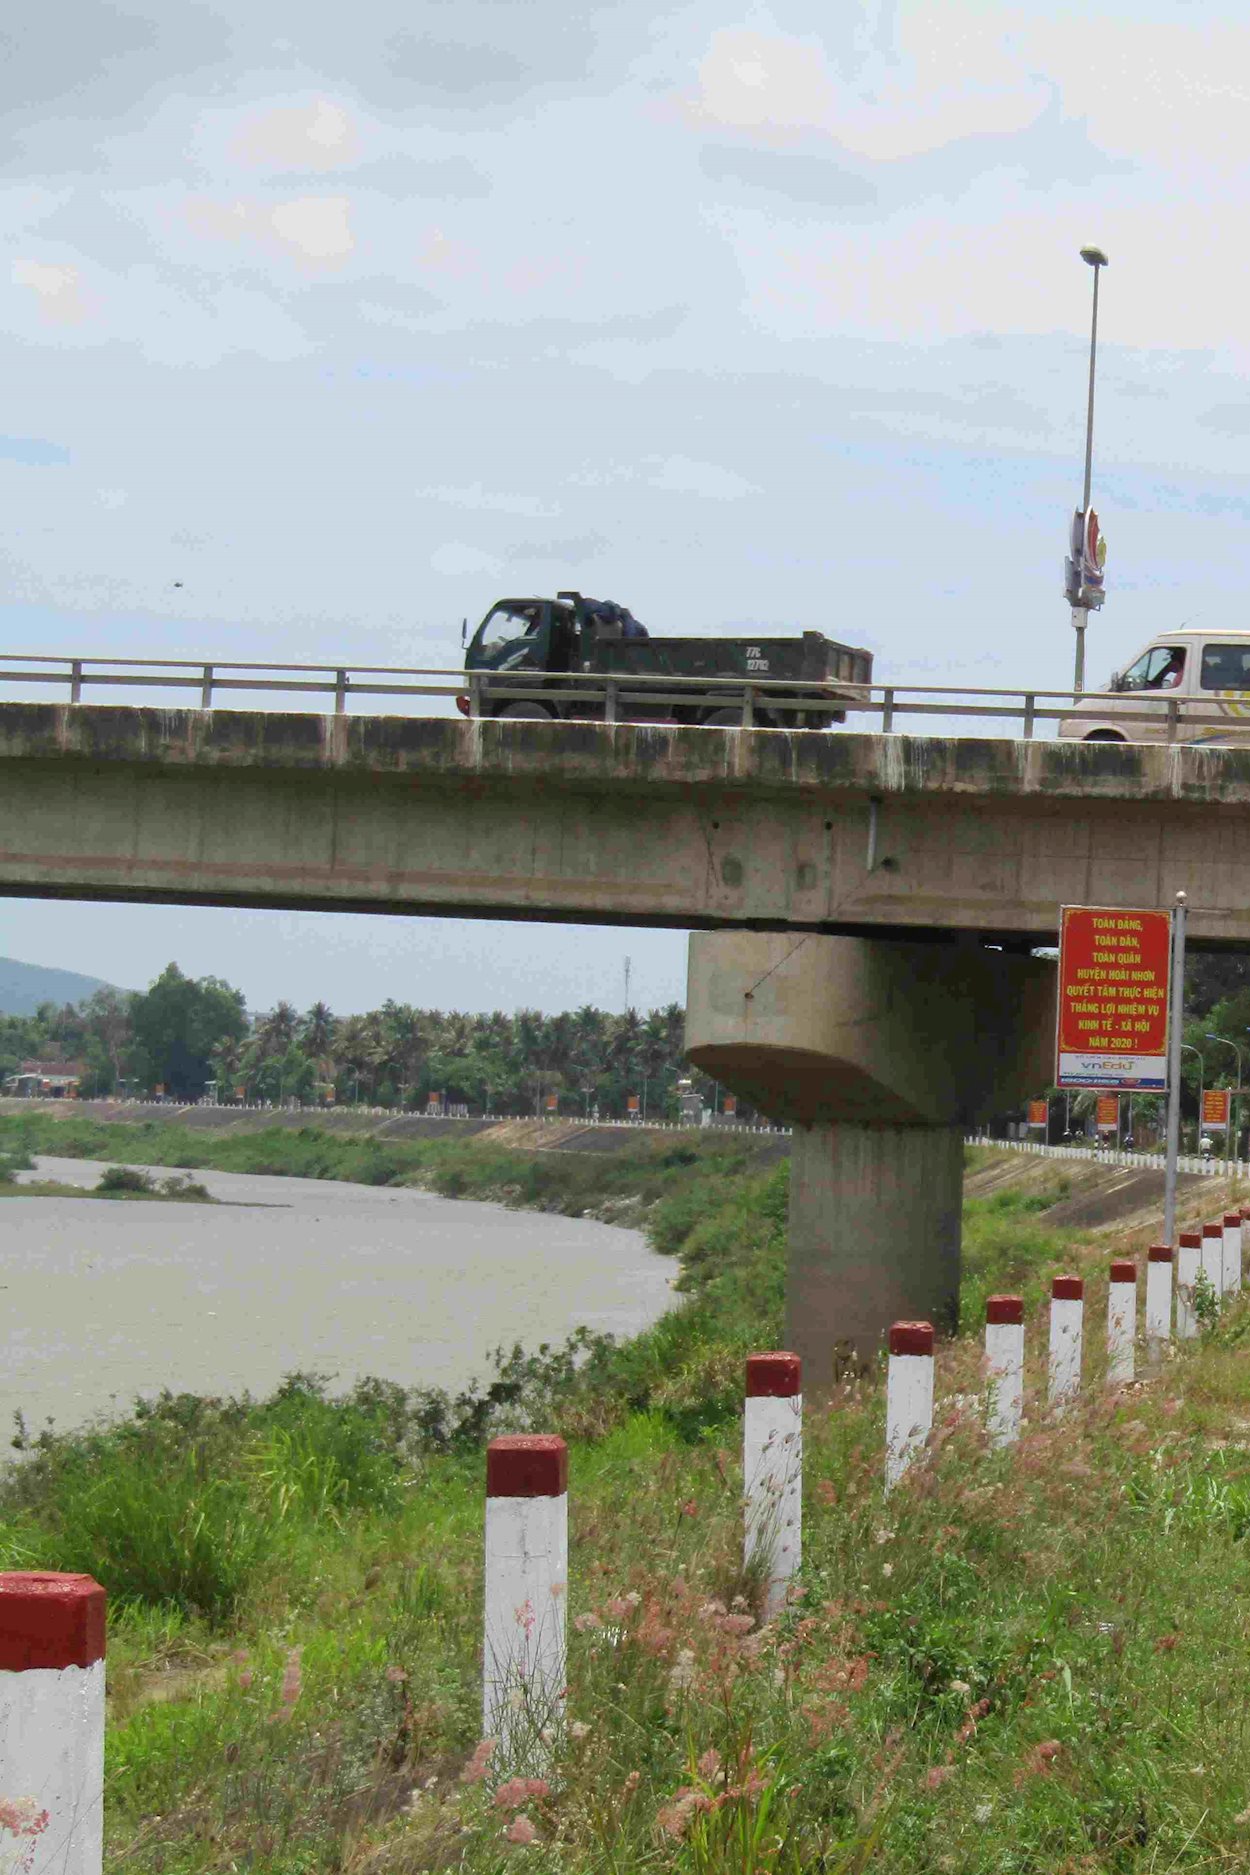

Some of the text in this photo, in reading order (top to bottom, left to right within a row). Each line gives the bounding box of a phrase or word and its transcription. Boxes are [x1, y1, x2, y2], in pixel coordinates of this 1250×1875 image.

[1093, 916, 1115, 929] TOÀN
[1094, 934, 1140, 948] TOÀN DÂN,
[1093, 951, 1141, 965] TOÀN QUÂN
[1077, 967, 1106, 981] HUYỆN
[1108, 967, 1129, 980] HOÀI
[1066, 983, 1164, 1000] QUYẾT TÂM THỰC HIỆN
[1070, 999, 1159, 1016] THẮNG LỢI NHIỆM VỤ
[1078, 1019, 1099, 1030] KINH
[1101, 1016, 1113, 1031] TẾ
[1134, 1019, 1150, 1033] HỘI
[1088, 1036, 1108, 1048] NĂM
[1110, 1037, 1132, 1049] 2020
